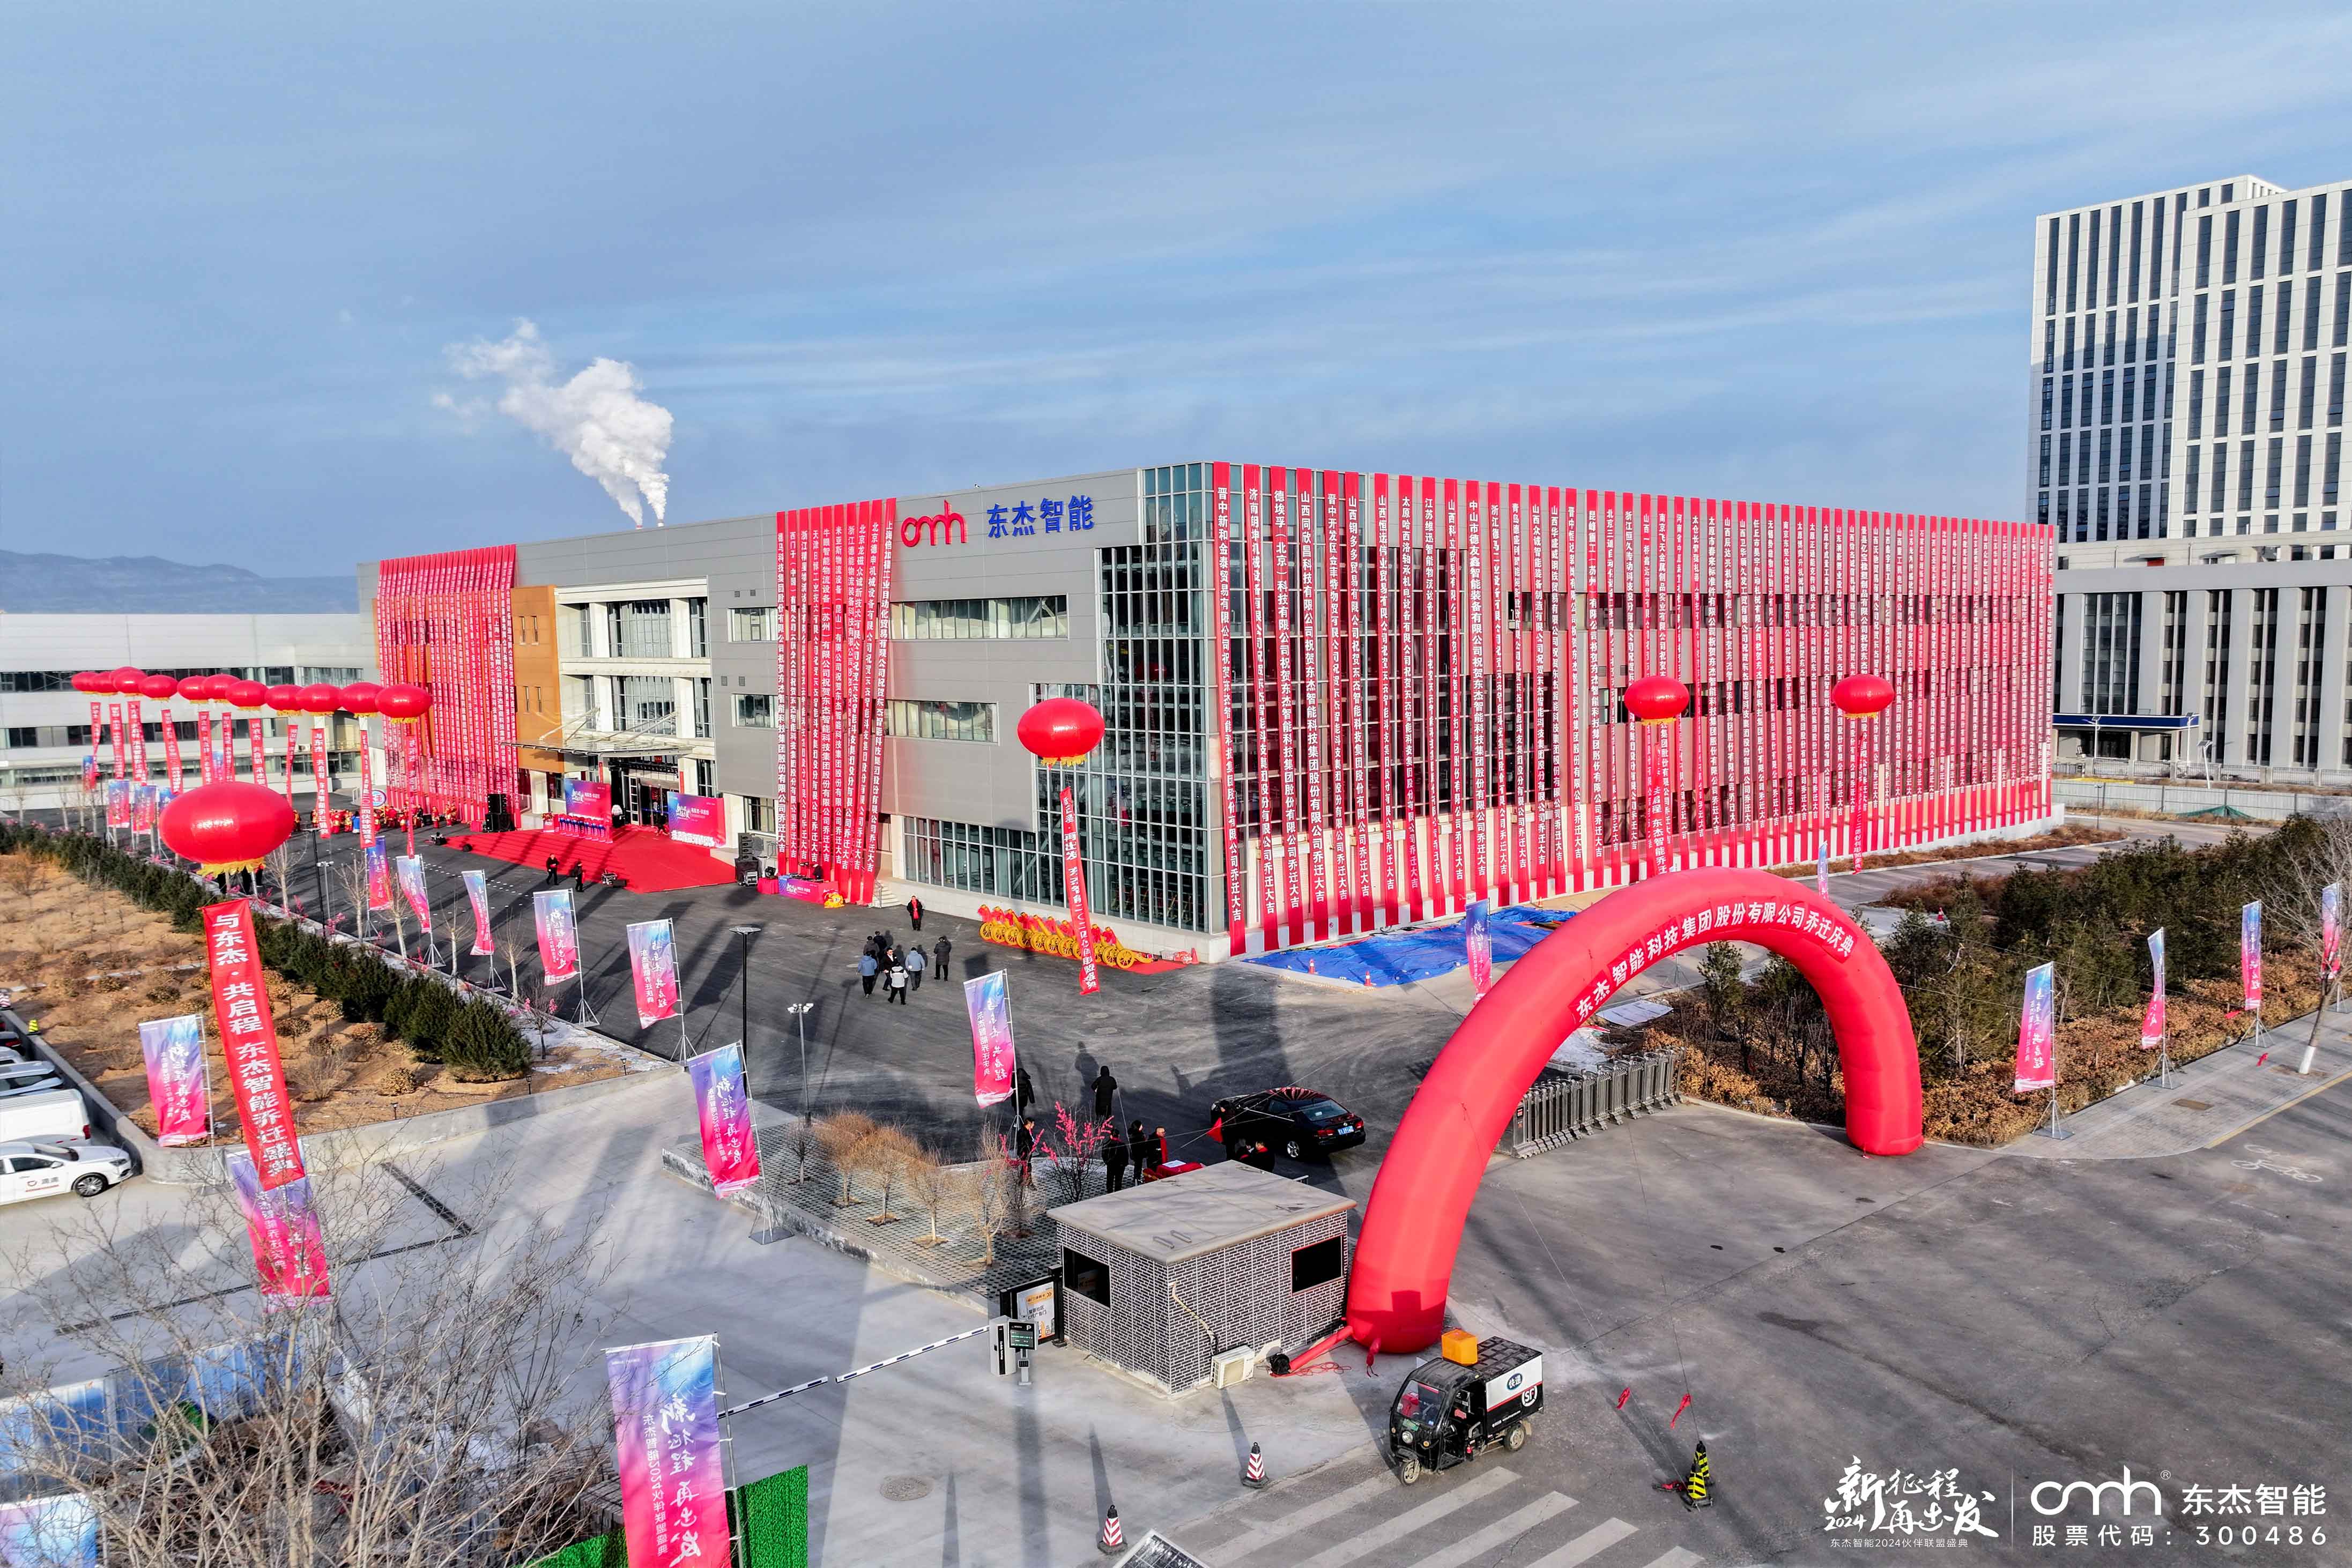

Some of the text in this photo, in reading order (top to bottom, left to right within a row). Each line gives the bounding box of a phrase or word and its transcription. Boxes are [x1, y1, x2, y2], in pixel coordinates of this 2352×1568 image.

[986, 495, 1095, 538] 东杰智能
[1301, 491, 1324, 902] 山西同欣昌科技有限公司祝贺东杰智能科技集团股份有限公司乔迁大吉
[212, 913, 264, 1035] 与东杰·共启程
[1576, 902, 1857, 1019] 东杰智能科技集团股份有限公司乔迁庆典
